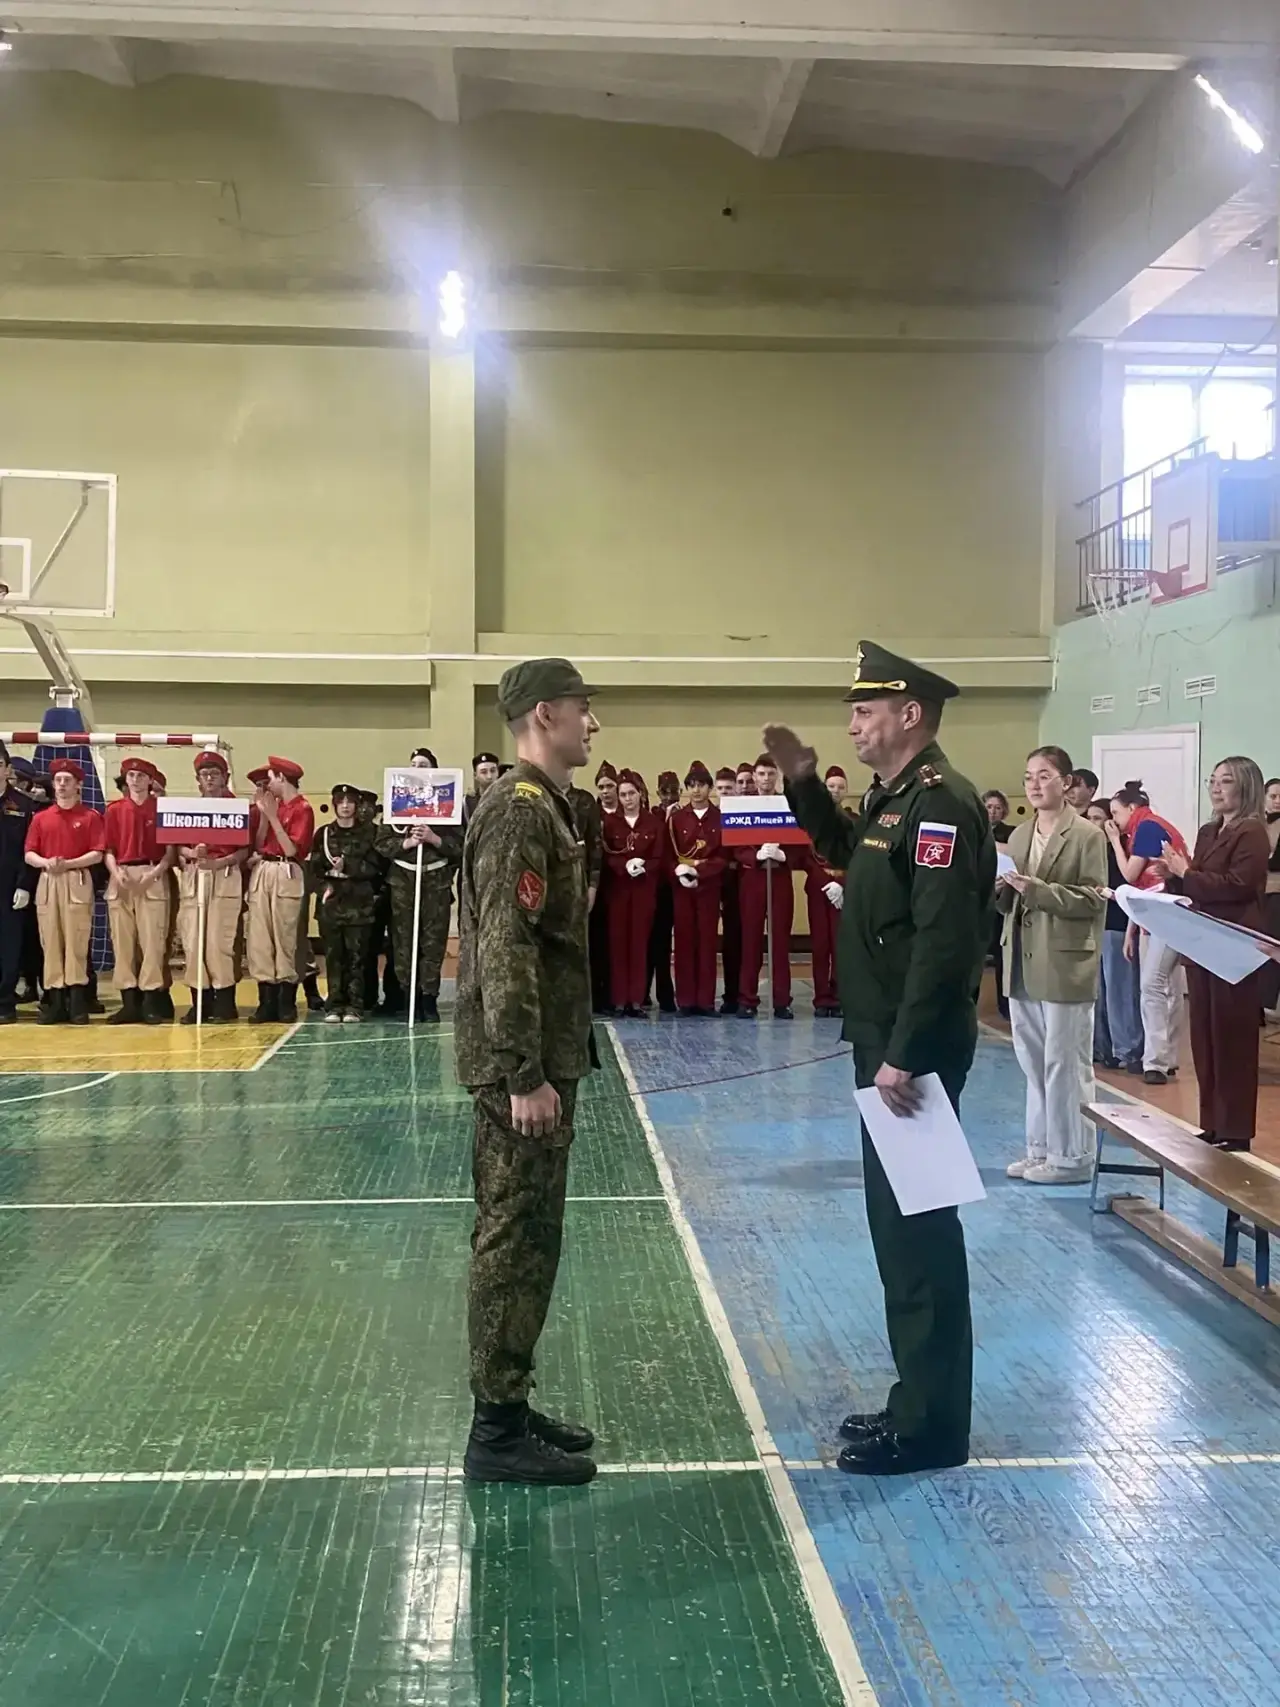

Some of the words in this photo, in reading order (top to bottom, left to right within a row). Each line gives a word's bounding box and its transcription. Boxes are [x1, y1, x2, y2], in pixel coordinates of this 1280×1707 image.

[162, 813, 210, 828] Школа
[212, 814, 244, 829] №46
[753, 815, 783, 825] Лицей
